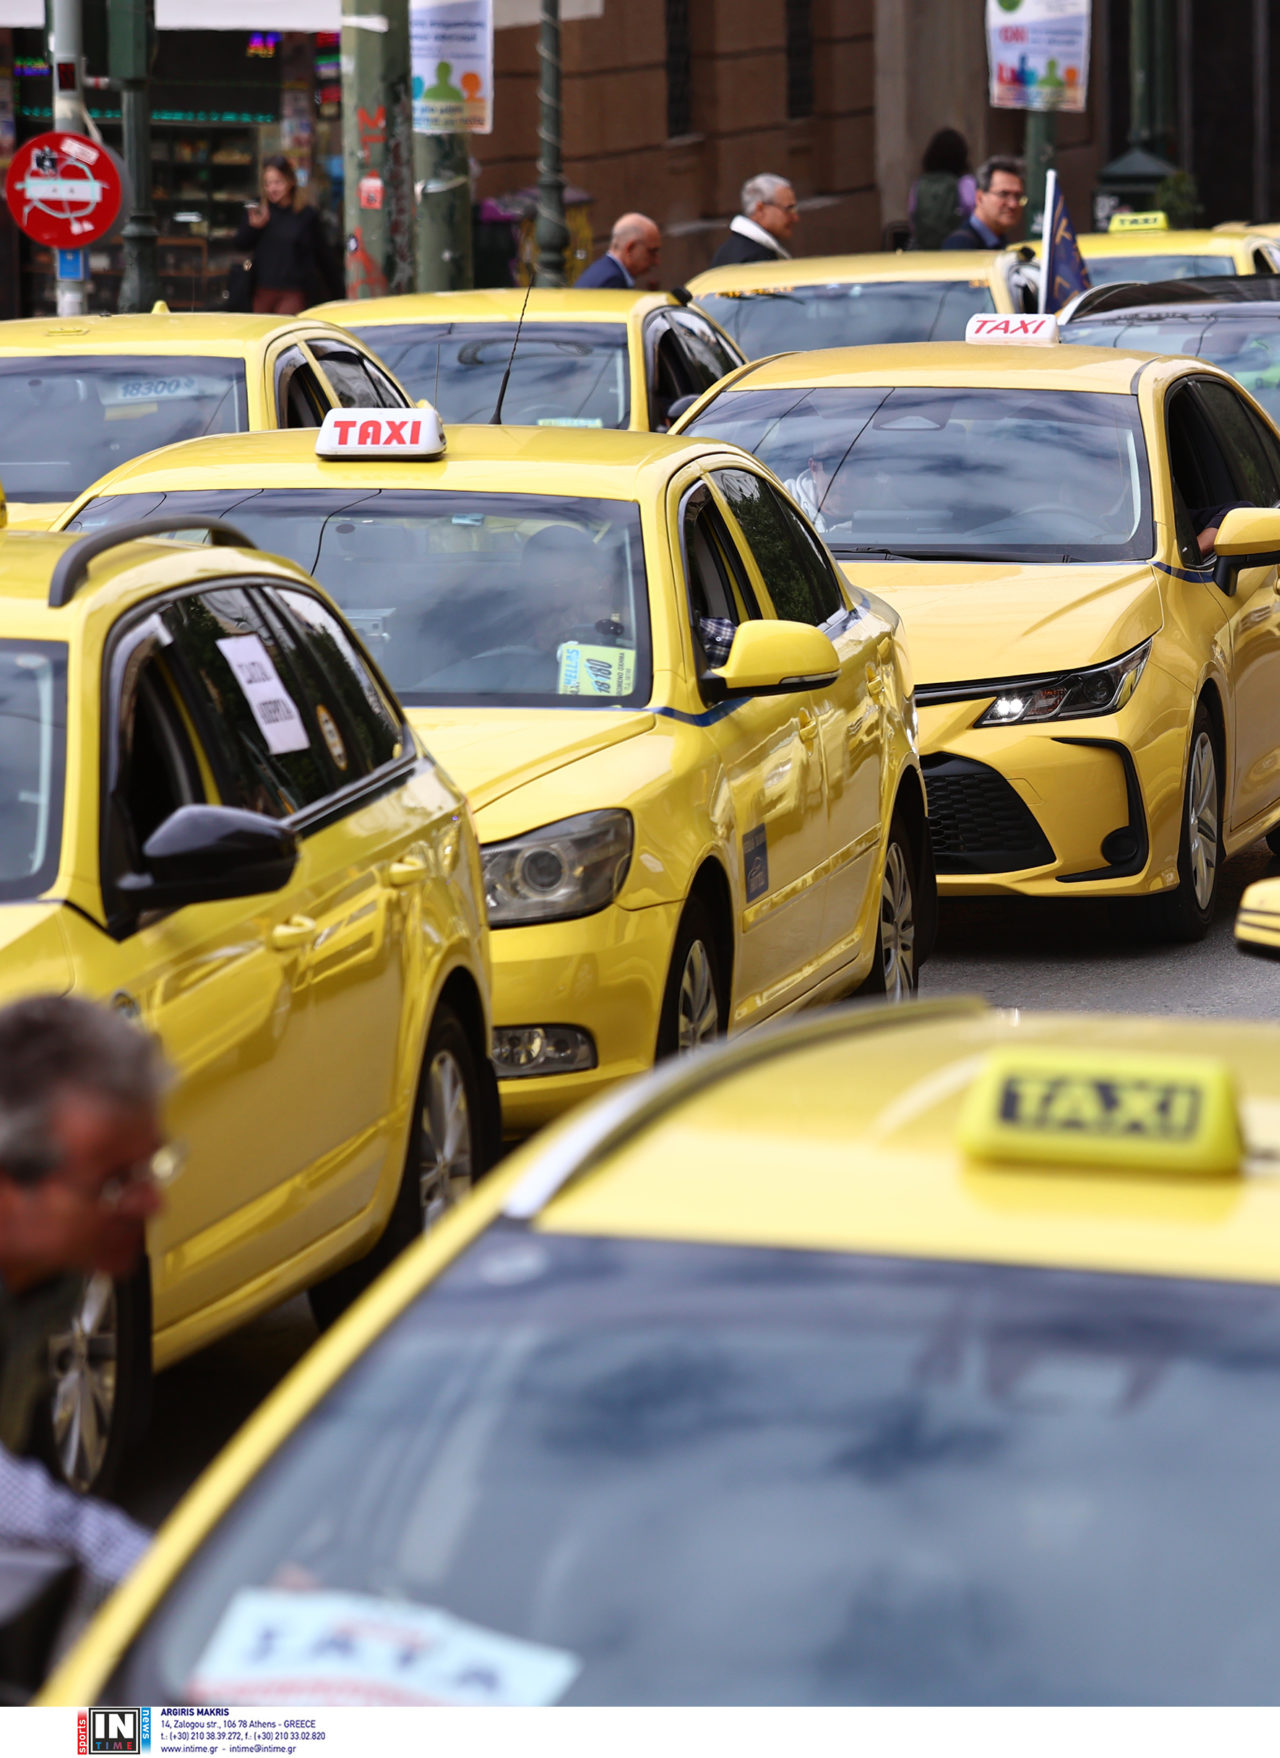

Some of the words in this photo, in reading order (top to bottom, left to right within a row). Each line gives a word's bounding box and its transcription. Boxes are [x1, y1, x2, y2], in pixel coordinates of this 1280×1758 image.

[974, 319, 1046, 335] TAXI
[121, 379, 180, 398] 18300
[333, 420, 421, 445] TAXI
[1010, 1075, 1195, 1137] TAXI
